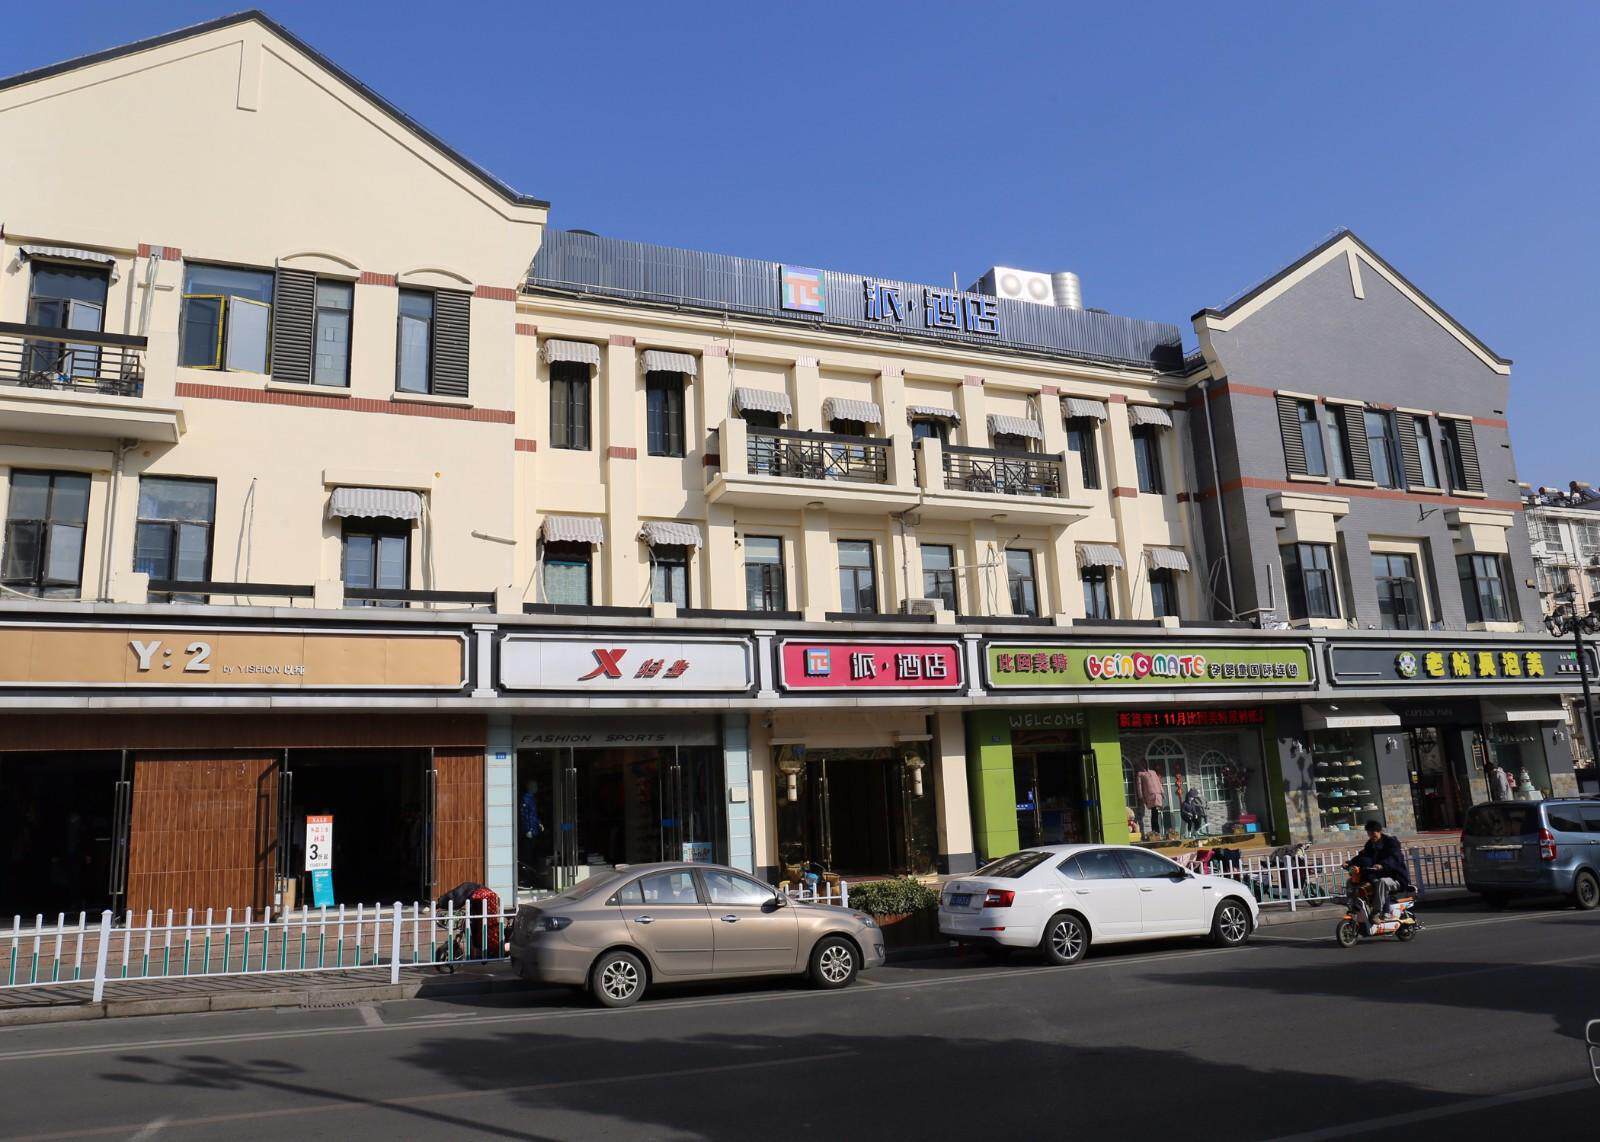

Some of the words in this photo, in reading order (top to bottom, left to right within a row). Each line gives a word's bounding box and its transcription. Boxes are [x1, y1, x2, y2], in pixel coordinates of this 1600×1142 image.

[237, 664, 280, 674] YISHION
[1008, 712, 1085, 728] WELCOME
[520, 734, 592, 743] FASHION
[605, 733, 666, 743] SPORTS
